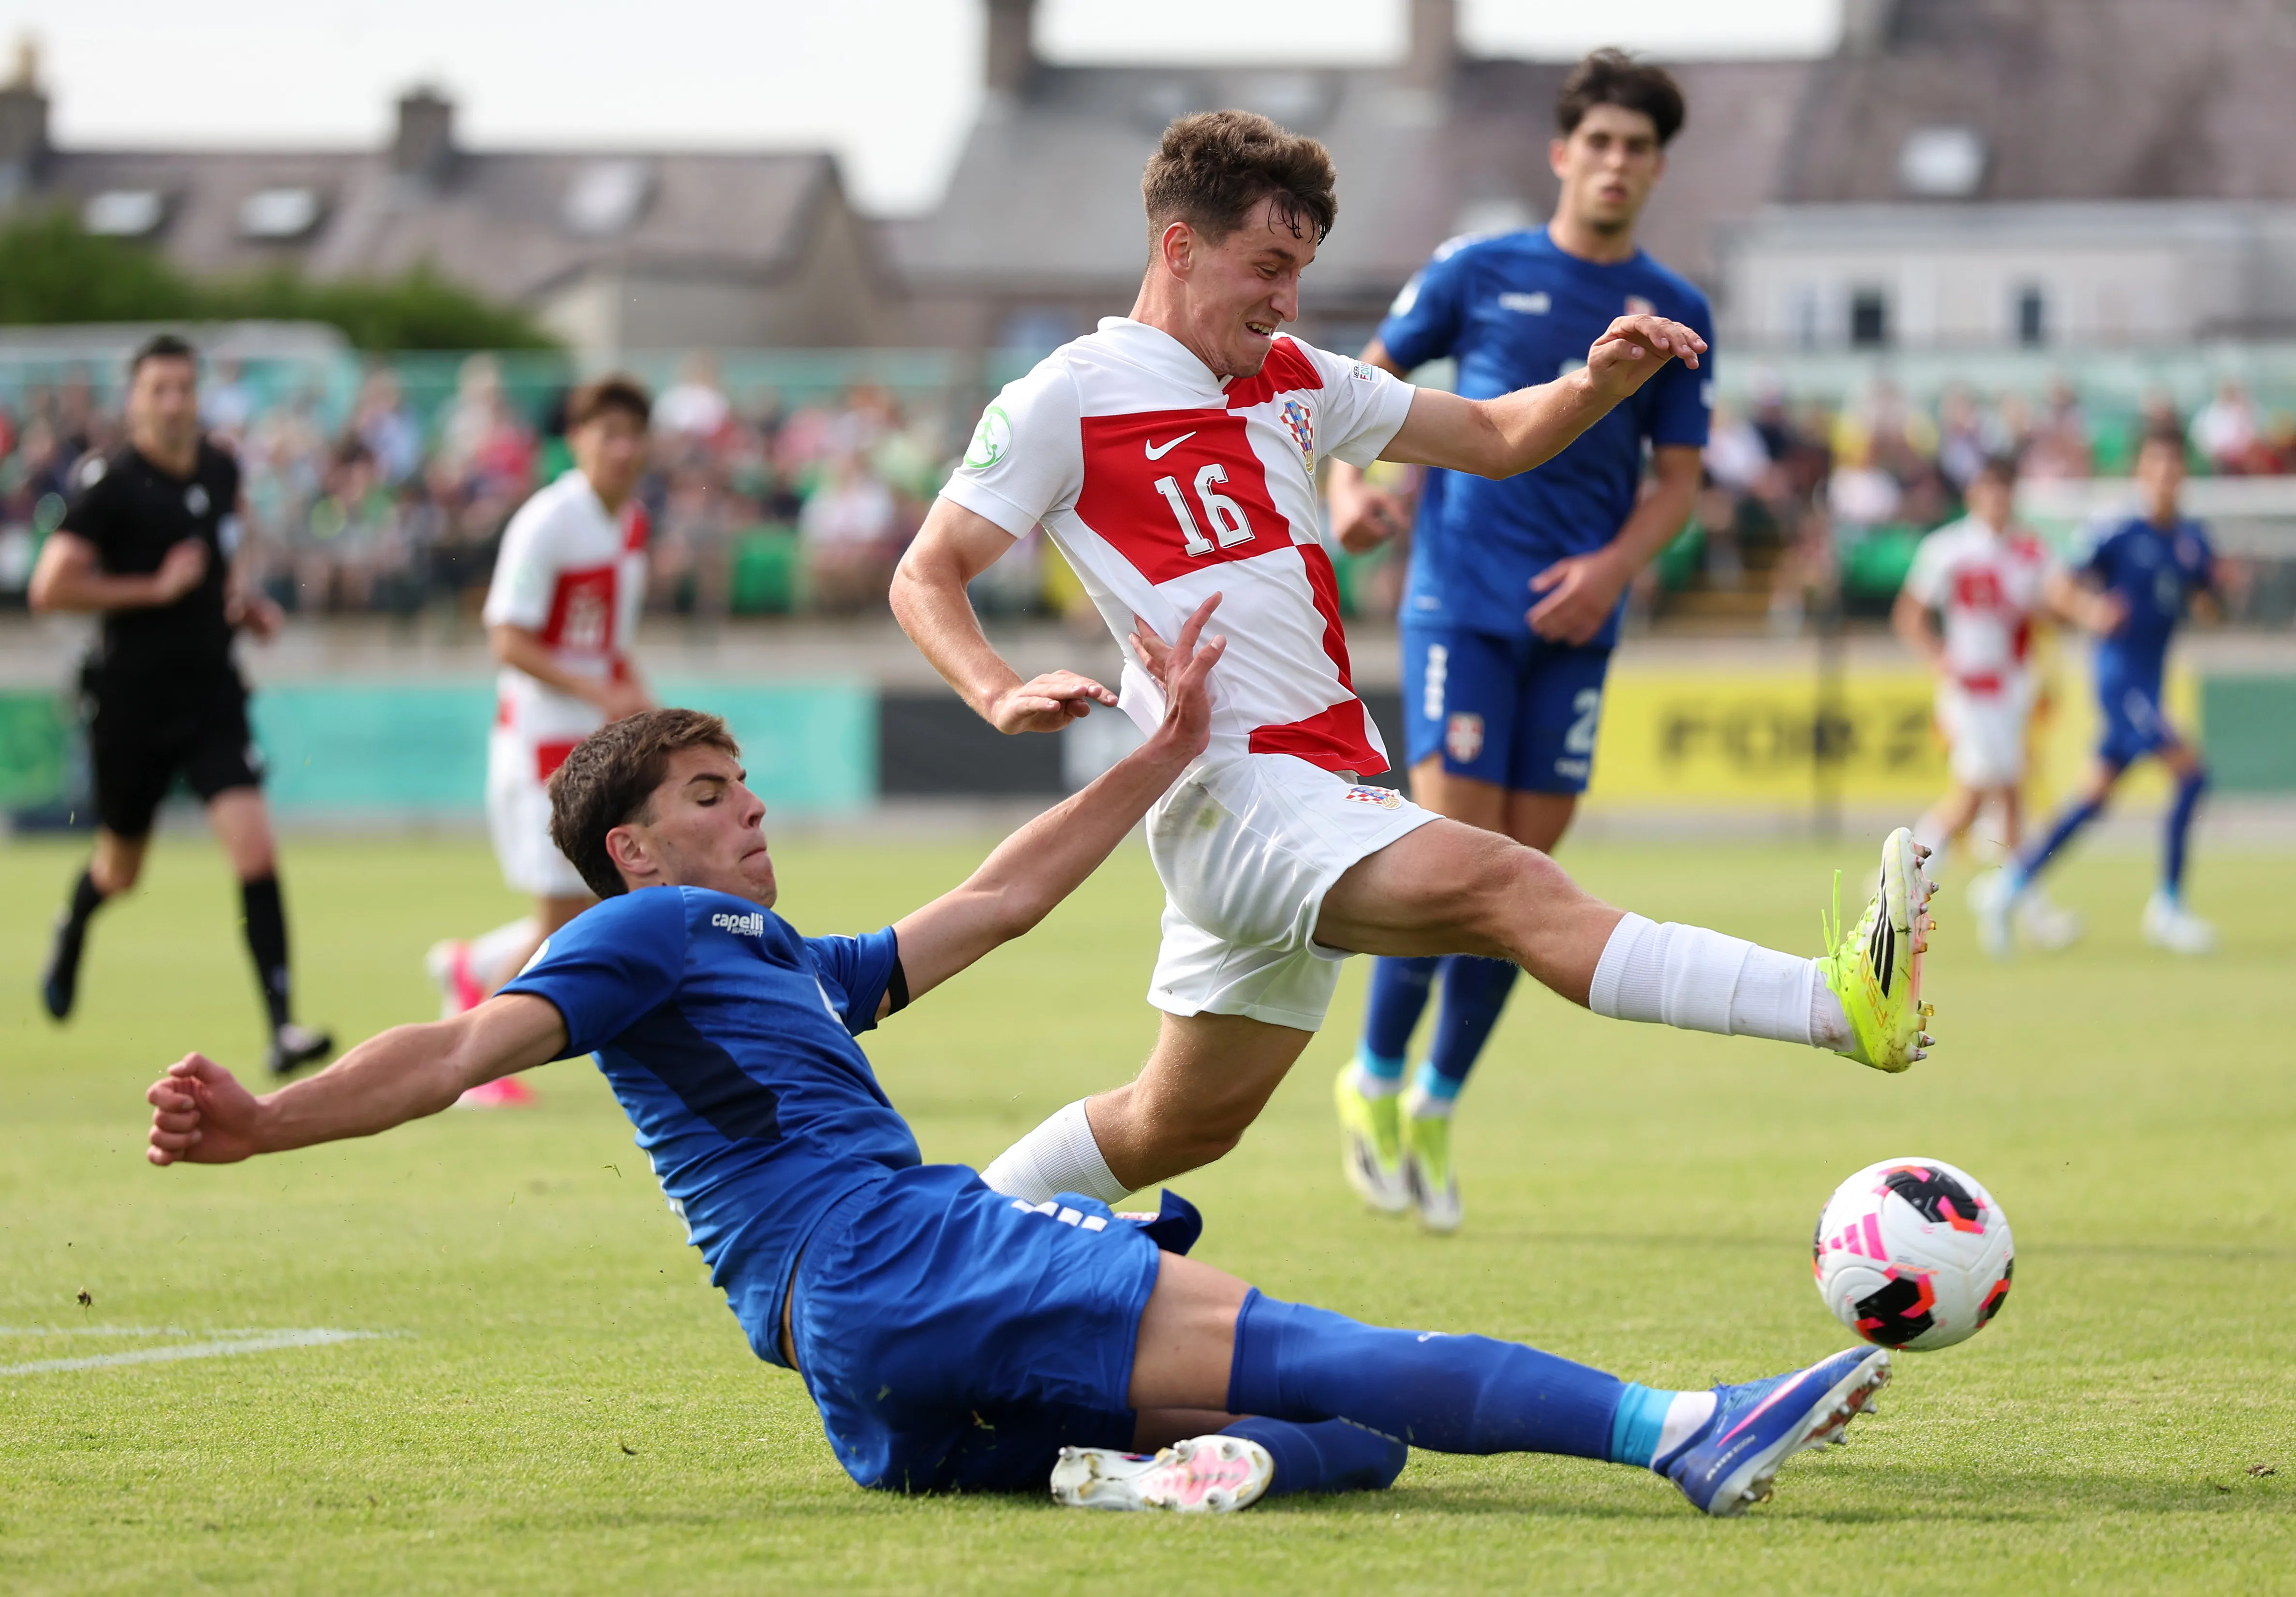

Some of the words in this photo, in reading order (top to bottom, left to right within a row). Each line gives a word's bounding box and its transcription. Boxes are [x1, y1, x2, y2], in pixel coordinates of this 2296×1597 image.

[1154, 463, 1256, 557] 16
[711, 912, 764, 932] capelli
[731, 927, 763, 938] SPORT
